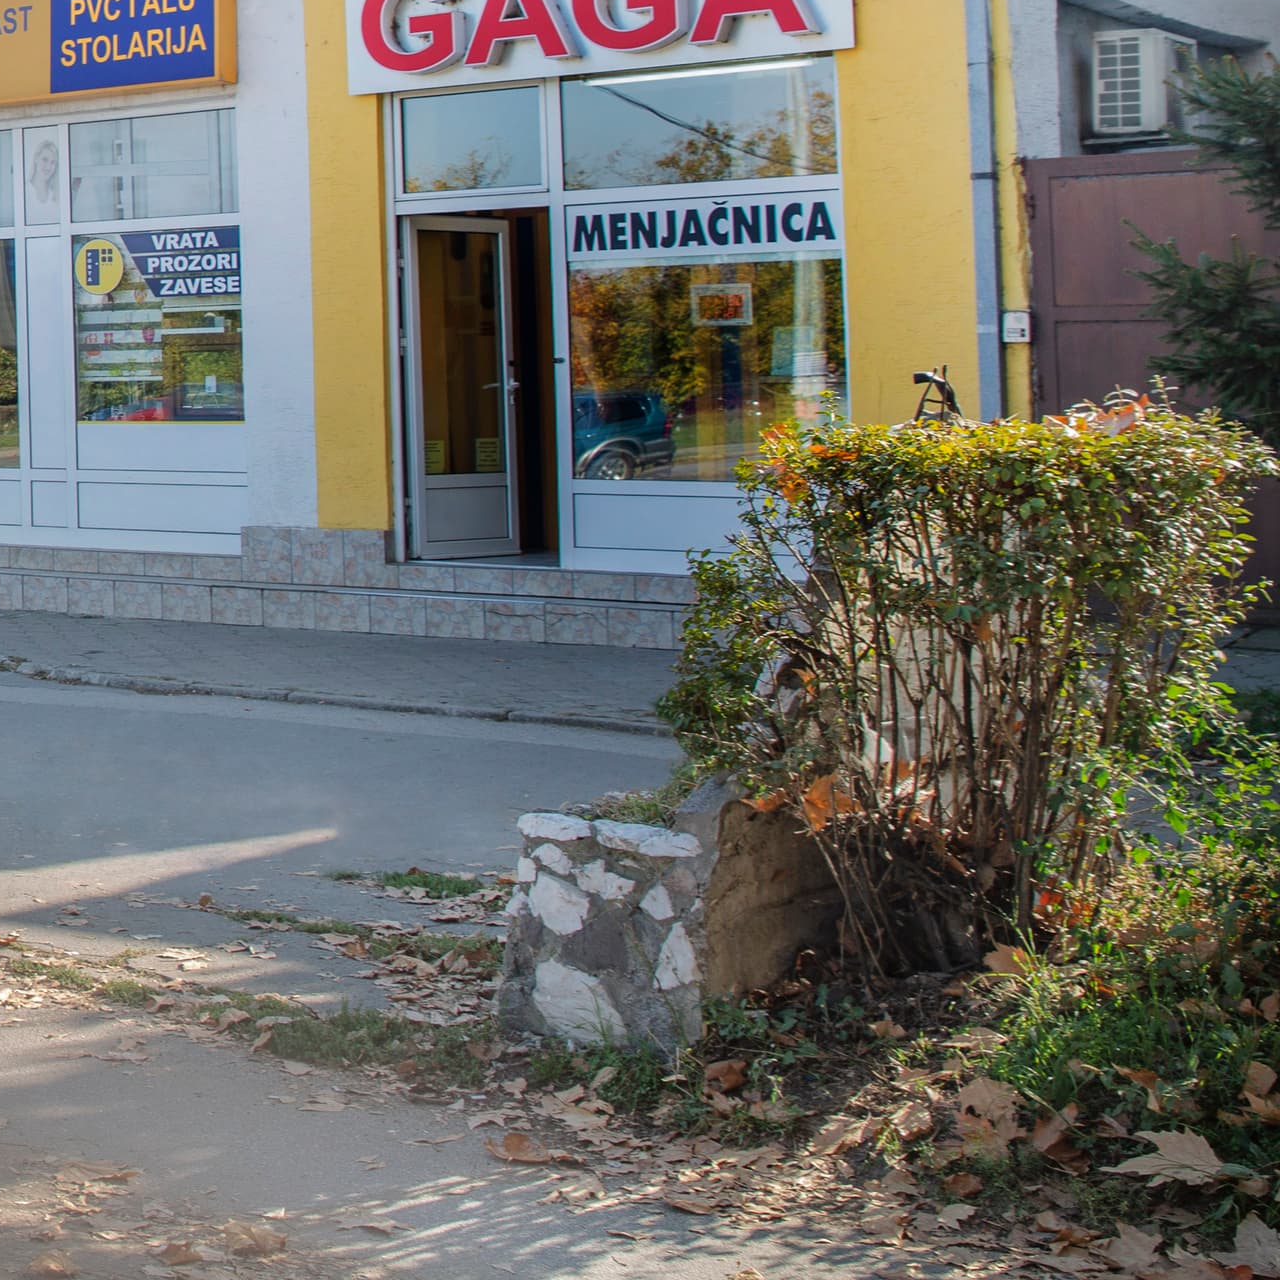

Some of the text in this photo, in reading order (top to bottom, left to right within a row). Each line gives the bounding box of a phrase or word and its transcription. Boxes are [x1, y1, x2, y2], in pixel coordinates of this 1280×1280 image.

[60, 23, 207, 67] STOLARIJA
[573, 201, 836, 252] MENJAČNICA
[151, 232, 219, 251] VRATA
[147, 253, 238, 273] PROZORI
[160, 276, 240, 295] ZAVESE
